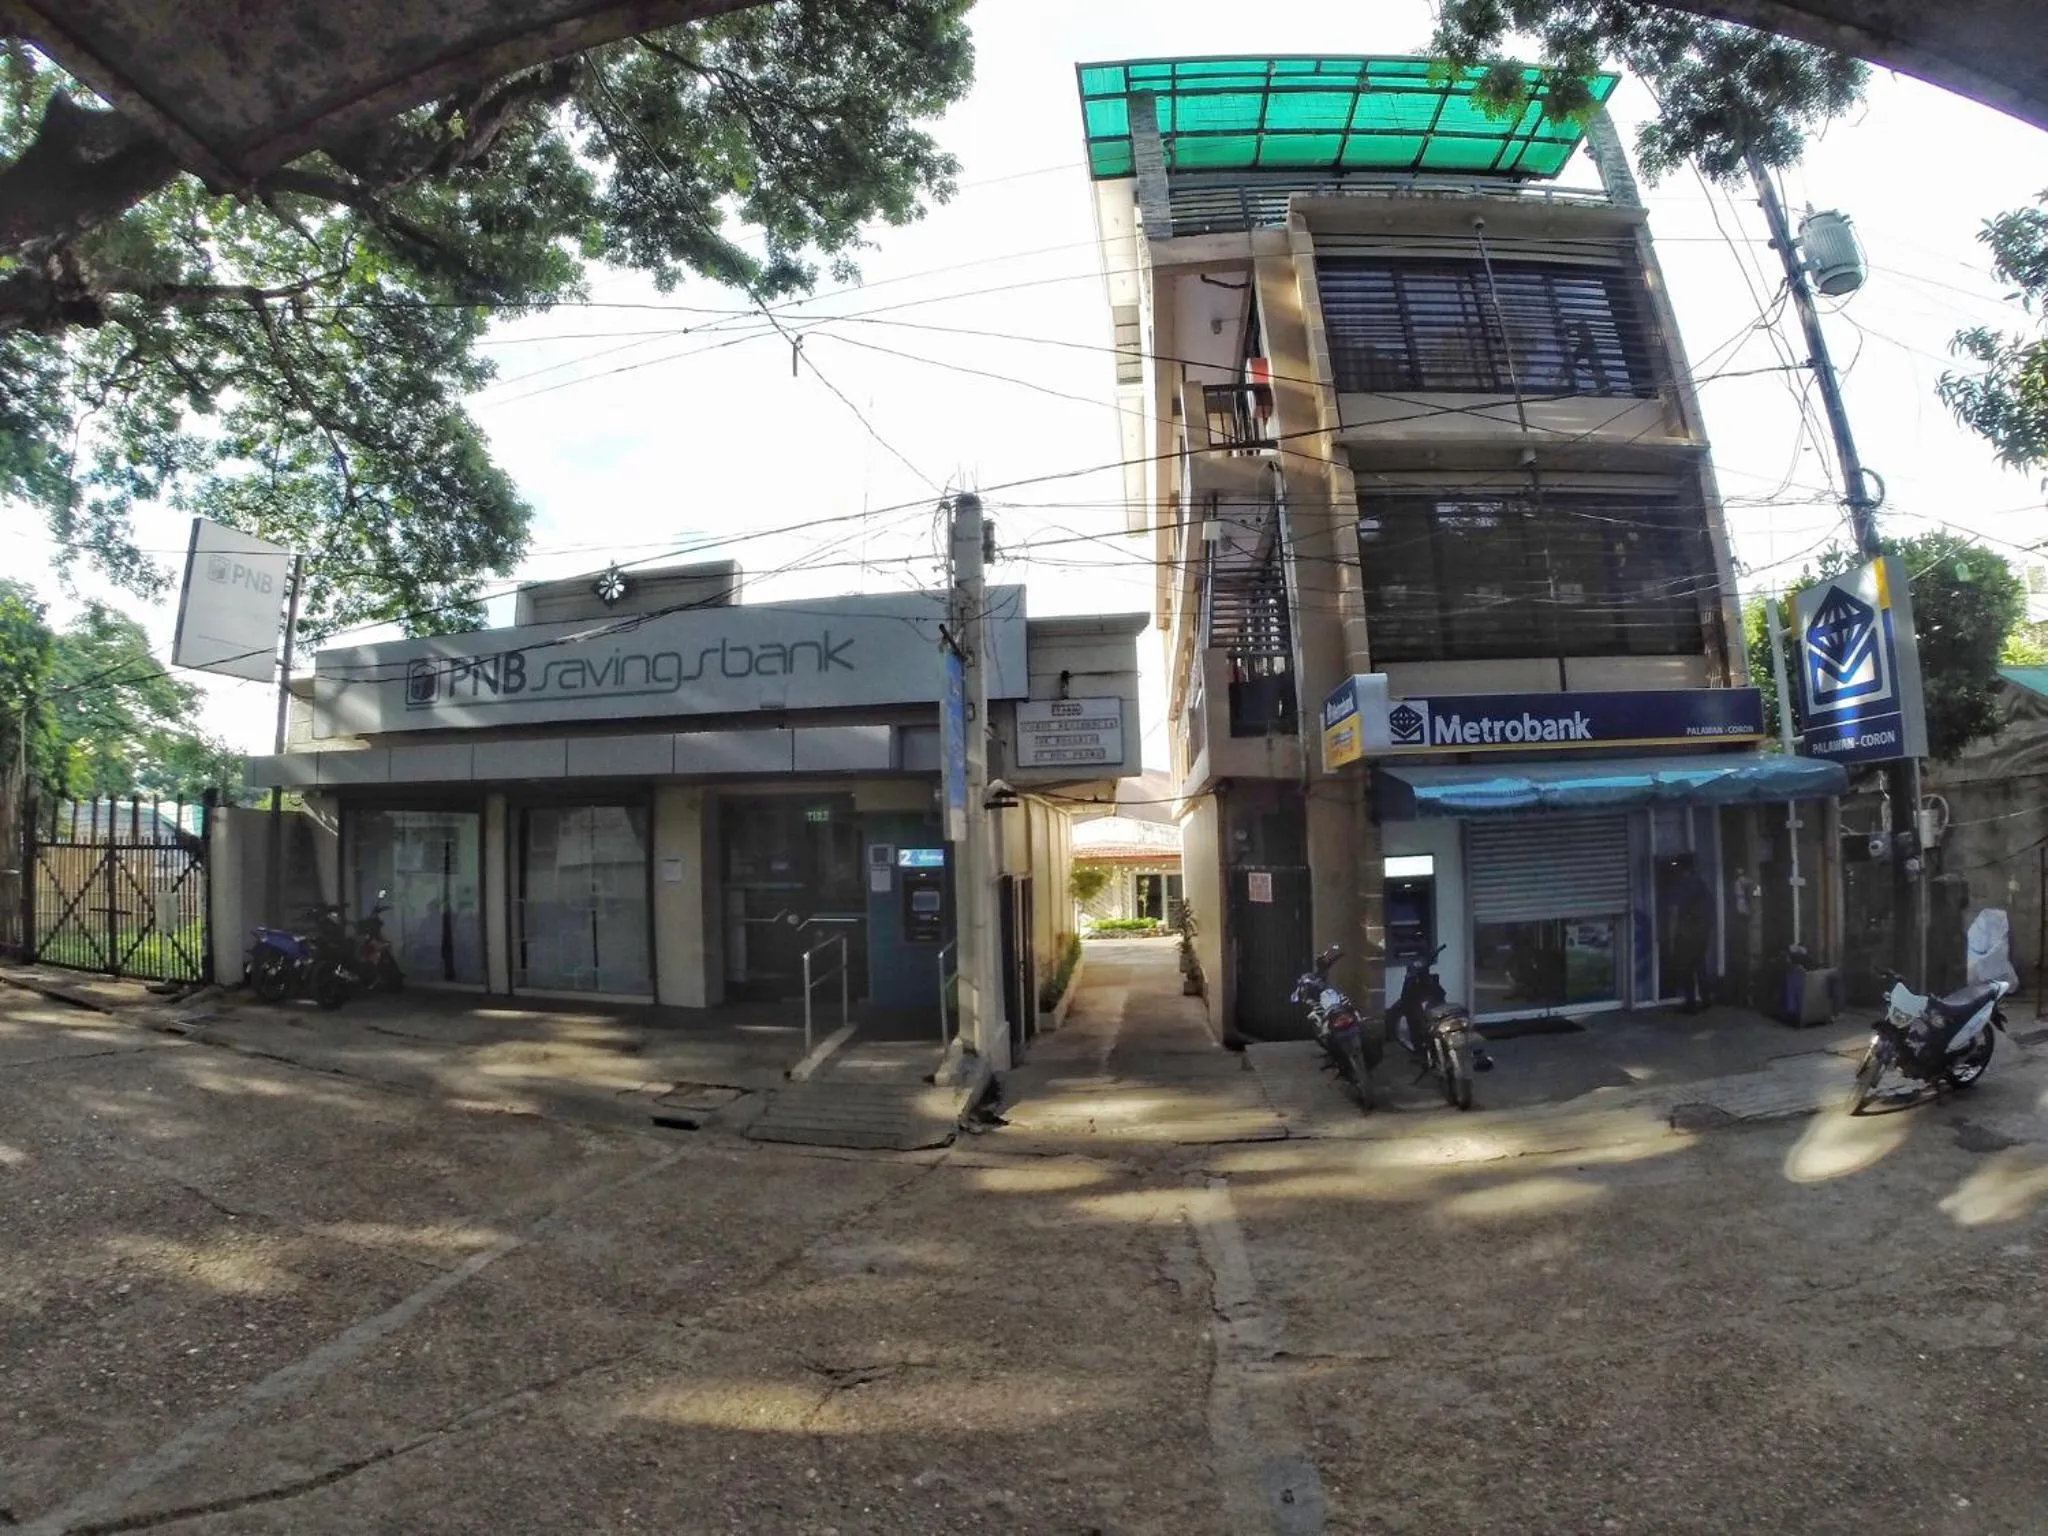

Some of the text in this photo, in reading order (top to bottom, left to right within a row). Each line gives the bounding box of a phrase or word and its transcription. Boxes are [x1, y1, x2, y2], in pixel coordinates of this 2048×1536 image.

[231, 563, 274, 595] PNB
[448, 650, 527, 698] PNB
[1434, 710, 1594, 745] Metrobank
